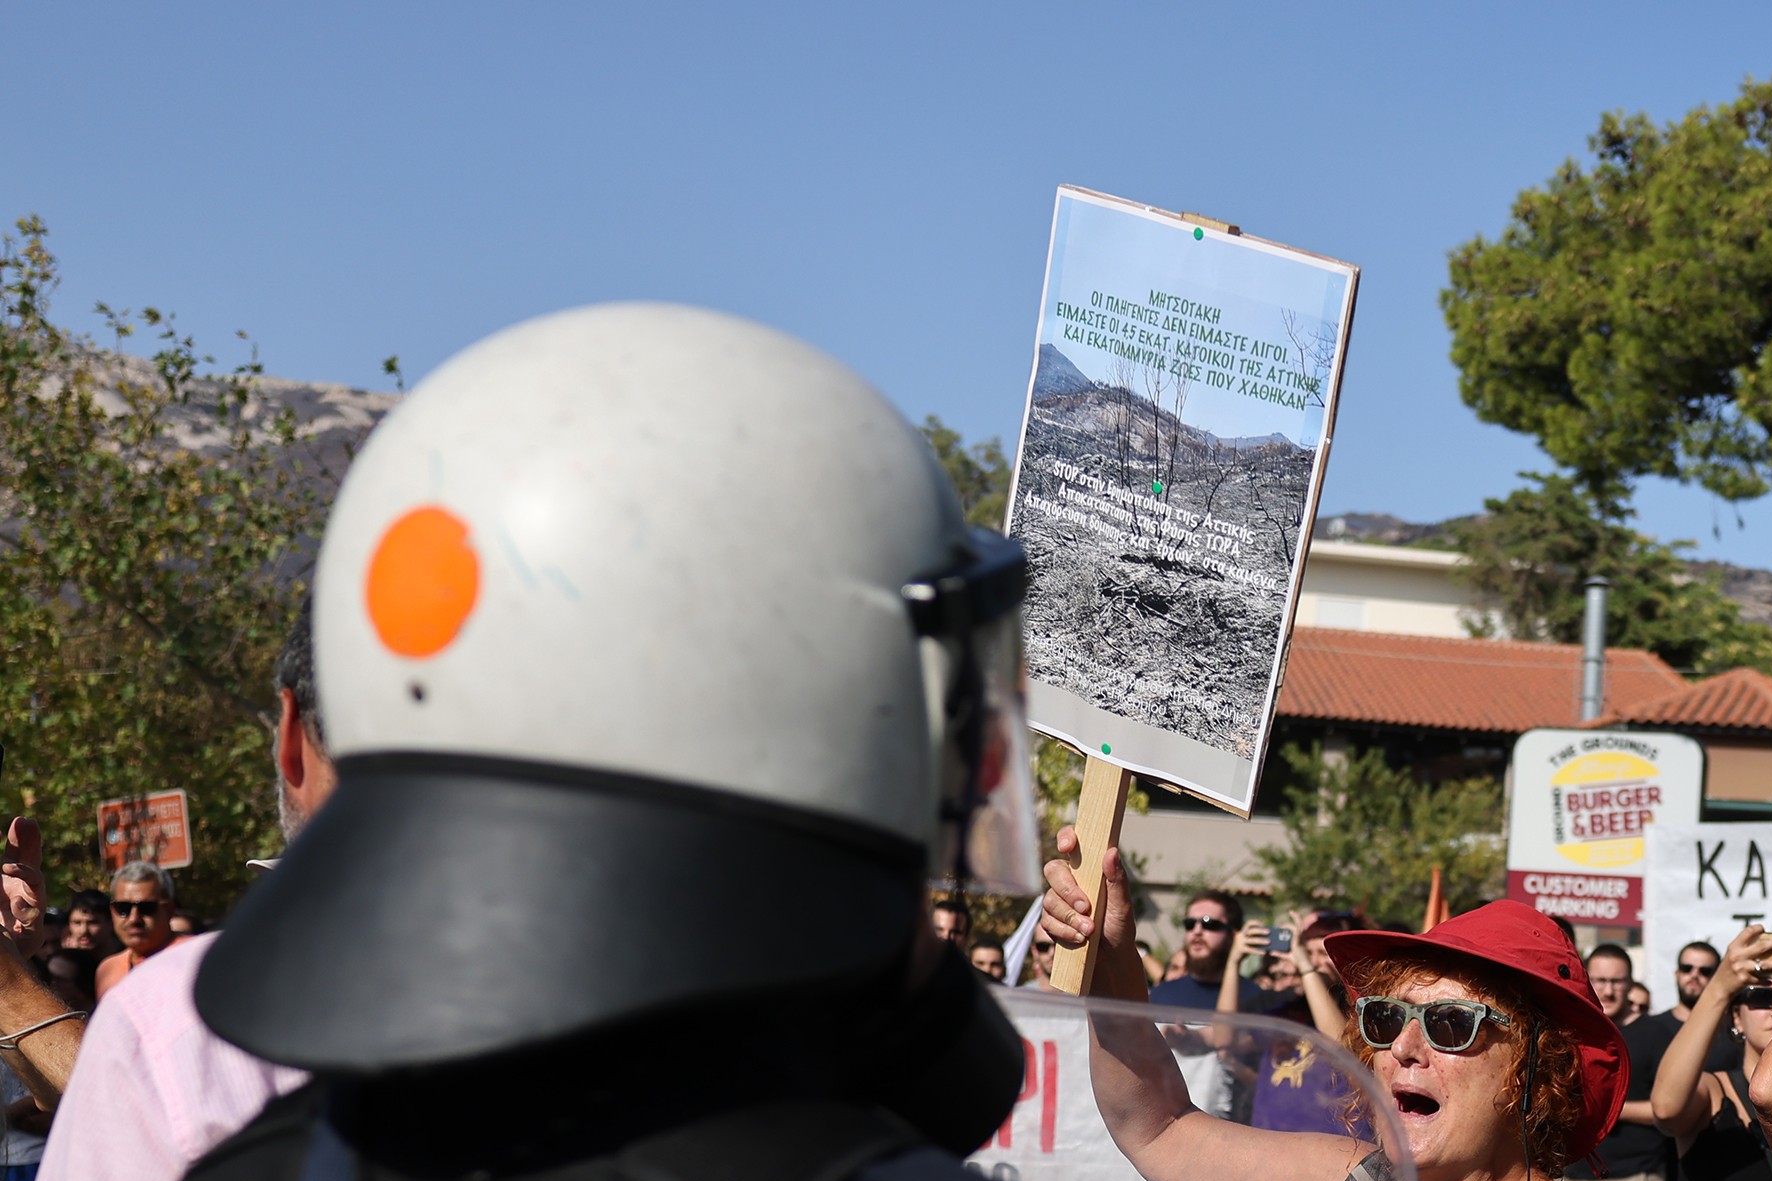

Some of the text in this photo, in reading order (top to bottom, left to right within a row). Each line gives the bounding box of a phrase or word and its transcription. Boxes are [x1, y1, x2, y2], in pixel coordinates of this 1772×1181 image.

[1091, 290, 1289, 365] ΟΙ ΠΛΗΓΕΝΤΕΣ ΔΕΝ ΕΙΜΑΣΤΕ ΛΙΓΟΙ.
[1149, 289, 1221, 325] ΜΗΤΣΟΤΑΚΗ
[1056, 301, 1107, 330] ΕΙΜΑΣΤΕ
[1109, 317, 1120, 334] ΟΙ
[1138, 328, 1171, 353] ΕΚΑΤ.
[1175, 338, 1235, 371] ΚΑΤΟΙΚΟΙ
[1239, 358, 1263, 378] ΤΗΣ
[1266, 365, 1321, 395] ΑΤΤΙΚΗΣ
[1063, 323, 1306, 411] ΚΑΙ ΕΚΑΤΟΜΜΥΡΙΑ ΖΩΕΣ ΠΟΥ ΧΑΘΗΚΑΝ
[1024, 490, 1087, 528] Απαγόρευση
[1202, 556, 1227, 574] στα
[1058, 482, 1133, 526] Αποκατάσταση
[1136, 515, 1159, 535] της
[1206, 532, 1241, 558] ΤΩΡΑ
[1079, 474, 1106, 492] στην
[1175, 509, 1200, 528] της
[1202, 511, 1256, 545] Αττικής
[1549, 745, 1576, 766] THE
[1567, 786, 1662, 813] BURGER
[1572, 814, 1586, 837] &
[1523, 873, 1629, 899] CUSTOMER
[1535, 894, 1620, 919] PARKING
